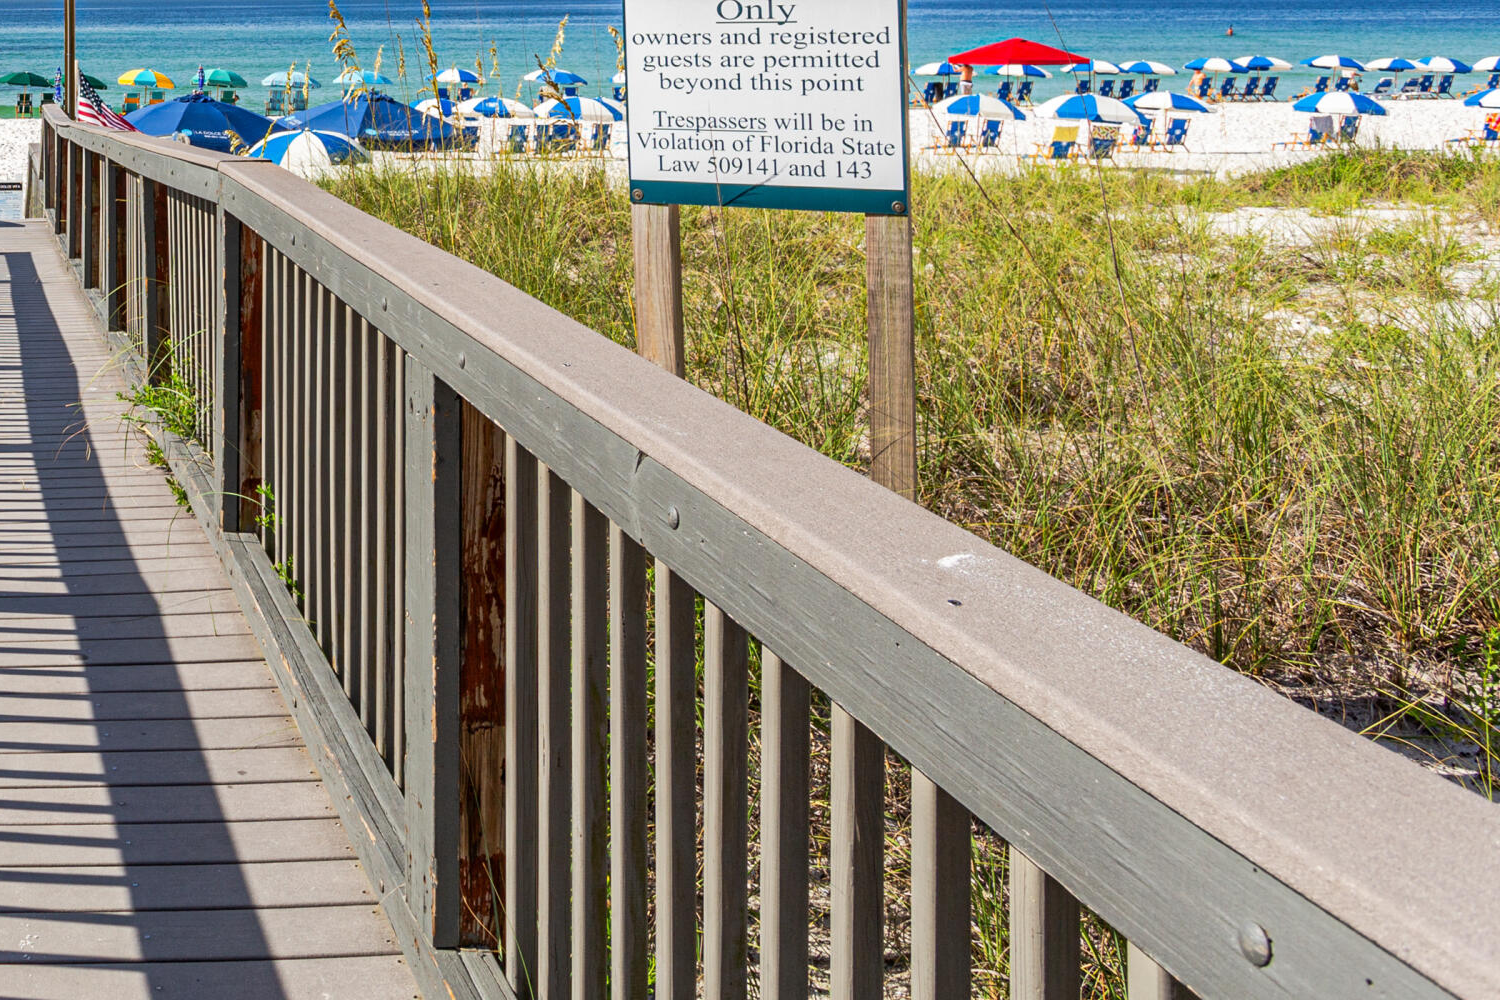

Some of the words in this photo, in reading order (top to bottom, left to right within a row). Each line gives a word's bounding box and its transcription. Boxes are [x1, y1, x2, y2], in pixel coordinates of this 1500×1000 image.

[632, 33, 712, 45] owners
[721, 28, 760, 44] and
[771, 27, 889, 51] registered
[644, 54, 711, 71] guests
[721, 56, 754, 67] are
[764, 50, 879, 72] permitted
[660, 73, 741, 94] beyond
[751, 74, 792, 90] this
[801, 74, 864, 96] point
[654, 111, 766, 134] Trespassers
[775, 113, 812, 130] will
[822, 114, 844, 131] be
[854, 114, 873, 131] in
[638, 133, 724, 150] Violation
[733, 135, 755, 151] of
[762, 136, 833, 154] Florida
[843, 138, 894, 156] State
[658, 155, 700, 172] Law
[707, 157, 779, 175] 509141
[789, 160, 825, 177] and
[836, 161, 872, 179] 143
